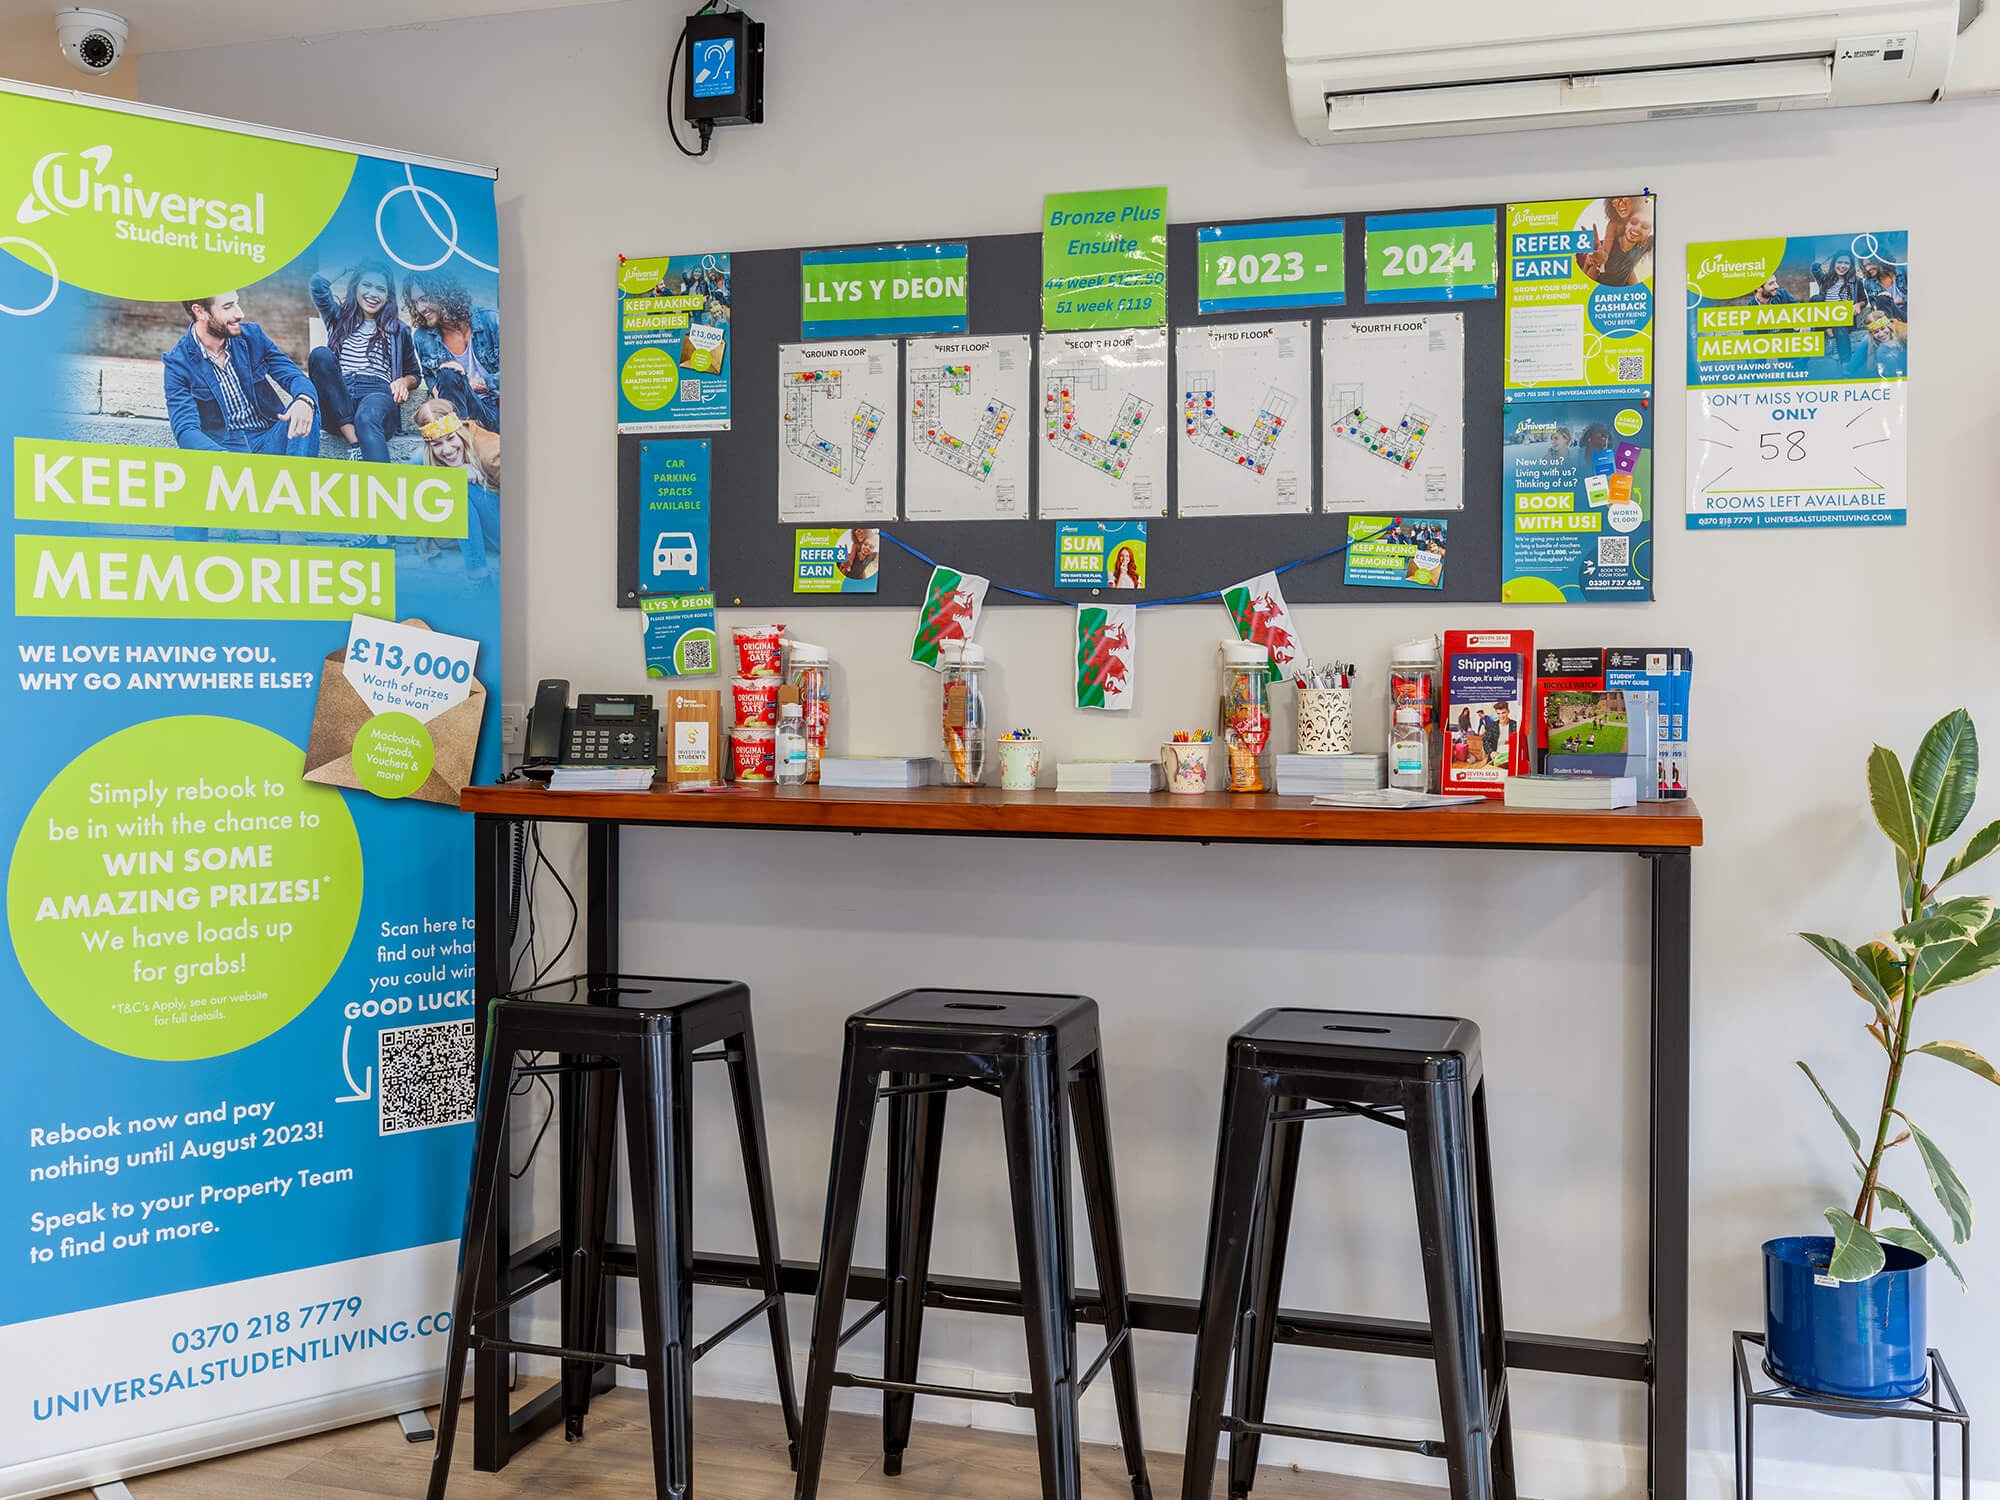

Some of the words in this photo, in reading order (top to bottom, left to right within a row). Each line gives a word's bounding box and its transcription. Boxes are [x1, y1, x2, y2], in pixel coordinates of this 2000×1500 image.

[53, 165, 265, 237] Universal
[1050, 210, 1116, 226] Bronze
[1121, 206, 1160, 222] Plus
[115, 219, 198, 250] Student
[204, 226, 265, 263] Living
[1067, 237, 1138, 255] Ensuite
[1516, 235, 1571, 252] REFER
[1577, 234, 1591, 249] &
[1382, 242, 1476, 277] 2024
[1706, 257, 1765, 273] Universal
[1216, 252, 1304, 286] 2023
[1516, 260, 1568, 277] EARN
[1067, 276, 1104, 288] week
[805, 281, 863, 303] LLYS
[870, 280, 885, 300] Y
[893, 276, 964, 299] DEON
[626, 300, 651, 311] KEEP
[654, 298, 700, 308] MAKING
[1595, 294, 1621, 302] EARN
[1056, 301, 1072, 313] 51
[1077, 299, 1113, 312] week
[1594, 302, 1647, 312] CASHBACK
[626, 316, 686, 329] MEMORIES!
[1703, 310, 1751, 327] KEEP
[1757, 304, 1848, 325] MAKING
[1241, 331, 1268, 339] FLOOR
[1356, 324, 1391, 333] FOURTH
[1394, 323, 1423, 331] FLOOR
[691, 330, 721, 341] £13,000
[805, 349, 838, 358] GROUND
[840, 348, 865, 358] FLOOR
[1702, 336, 1819, 356] MEMORIES!
[1756, 393, 1792, 404] MISS
[1796, 390, 1838, 403] YOUR
[1844, 389, 1890, 400] PLACE
[1772, 408, 1818, 420] ONLY
[1521, 421, 1556, 430] Universal
[1760, 430, 1807, 461] 58
[666, 459, 685, 468] CAR
[1516, 458, 1537, 466] New
[1550, 457, 1564, 465] us?
[654, 473, 696, 482] PARKING
[1515, 470, 1539, 478] Living
[1542, 468, 1560, 476] with
[1562, 468, 1576, 476] us?
[33, 454, 186, 508] KEEP
[205, 465, 454, 522] MAKING
[1516, 480, 1549, 489] Thinking
[1552, 479, 1561, 487] of
[1564, 479, 1578, 487] us?
[658, 488, 692, 496] SPACES
[649, 501, 701, 510] AVAILABLE
[1519, 496, 1570, 509] BOOK
[1707, 496, 1765, 509] ROOMS
[1770, 495, 1800, 508] LEFT
[1805, 494, 1886, 506] AVAILABLE
[1519, 517, 1563, 528] WITH
[1569, 516, 1596, 528] US!
[1764, 514, 1892, 524] UNIVERSALSTUDENTLIVING.COM
[1064, 538, 1101, 550] SUM
[1352, 544, 1374, 552] KEEP
[1376, 545, 1415, 553] MAKING
[801, 550, 834, 560] REFER
[837, 550, 845, 560] &
[1064, 556, 1099, 569] MER
[32, 550, 381, 606] MEMORIES!
[800, 566, 832, 576] EARN
[644, 602, 668, 610] LLYS
[682, 598, 711, 607] DEON
[18, 645, 56, 663] WE
[61, 645, 120, 663] LOVE
[126, 646, 216, 663] HAVING
[222, 647, 276, 663] YOU.
[350, 639, 470, 683] £13,000
[750, 653, 769, 662] OATS
[1458, 658, 1511, 672] Shipping
[18, 672, 78, 690] WHY
[83, 672, 121, 690] GO
[127, 672, 253, 689] ANYWHERE
[259, 672, 313, 689] ELSE?
[363, 673, 398, 691] Worth
[401, 683, 414, 692] of
[415, 686, 449, 701] prizes
[738, 694, 768, 702] ORIGINAL
[743, 705, 762, 713] OATS
[371, 729, 422, 747] Macbooks,
[374, 743, 414, 759] Airpods,
[736, 746, 765, 754] ORIGINAL
[366, 754, 408, 771] Vouchers
[411, 763, 418, 771] &
[741, 757, 760, 765] OATS
[377, 770, 404, 782] more!
[89, 779, 169, 808] Simply
[176, 776, 256, 800] rebook
[263, 779, 284, 797] to
[49, 819, 79, 840] be
[87, 820, 108, 838] in
[116, 814, 164, 838] with
[172, 812, 206, 834] the
[214, 810, 292, 832] chance
[300, 810, 320, 828] to
[103, 851, 173, 877] WIN
[184, 845, 272, 872] SOME
[152, 998, 186, 1011] Apply,
[190, 999, 206, 1007] see
[229, 991, 268, 1003] website
[154, 1015, 168, 1026] for
[172, 1013, 186, 1024] full
[190, 1010, 225, 1022] details.
[30, 1117, 121, 1148] Rebook
[128, 1114, 179, 1134] now
[184, 1102, 227, 1125] and
[234, 1100, 275, 1125] pay
[30, 1151, 119, 1182] nothing
[127, 1141, 174, 1168] until
[180, 1134, 257, 1161] August
[262, 1121, 324, 1148] 2023!
[171, 1322, 239, 1354] 0370
[246, 1311, 290, 1338] 218
[299, 1296, 362, 1329] 7779
[33, 1311, 454, 1422] UNIVERSALSTUDENTLIVING.CO
